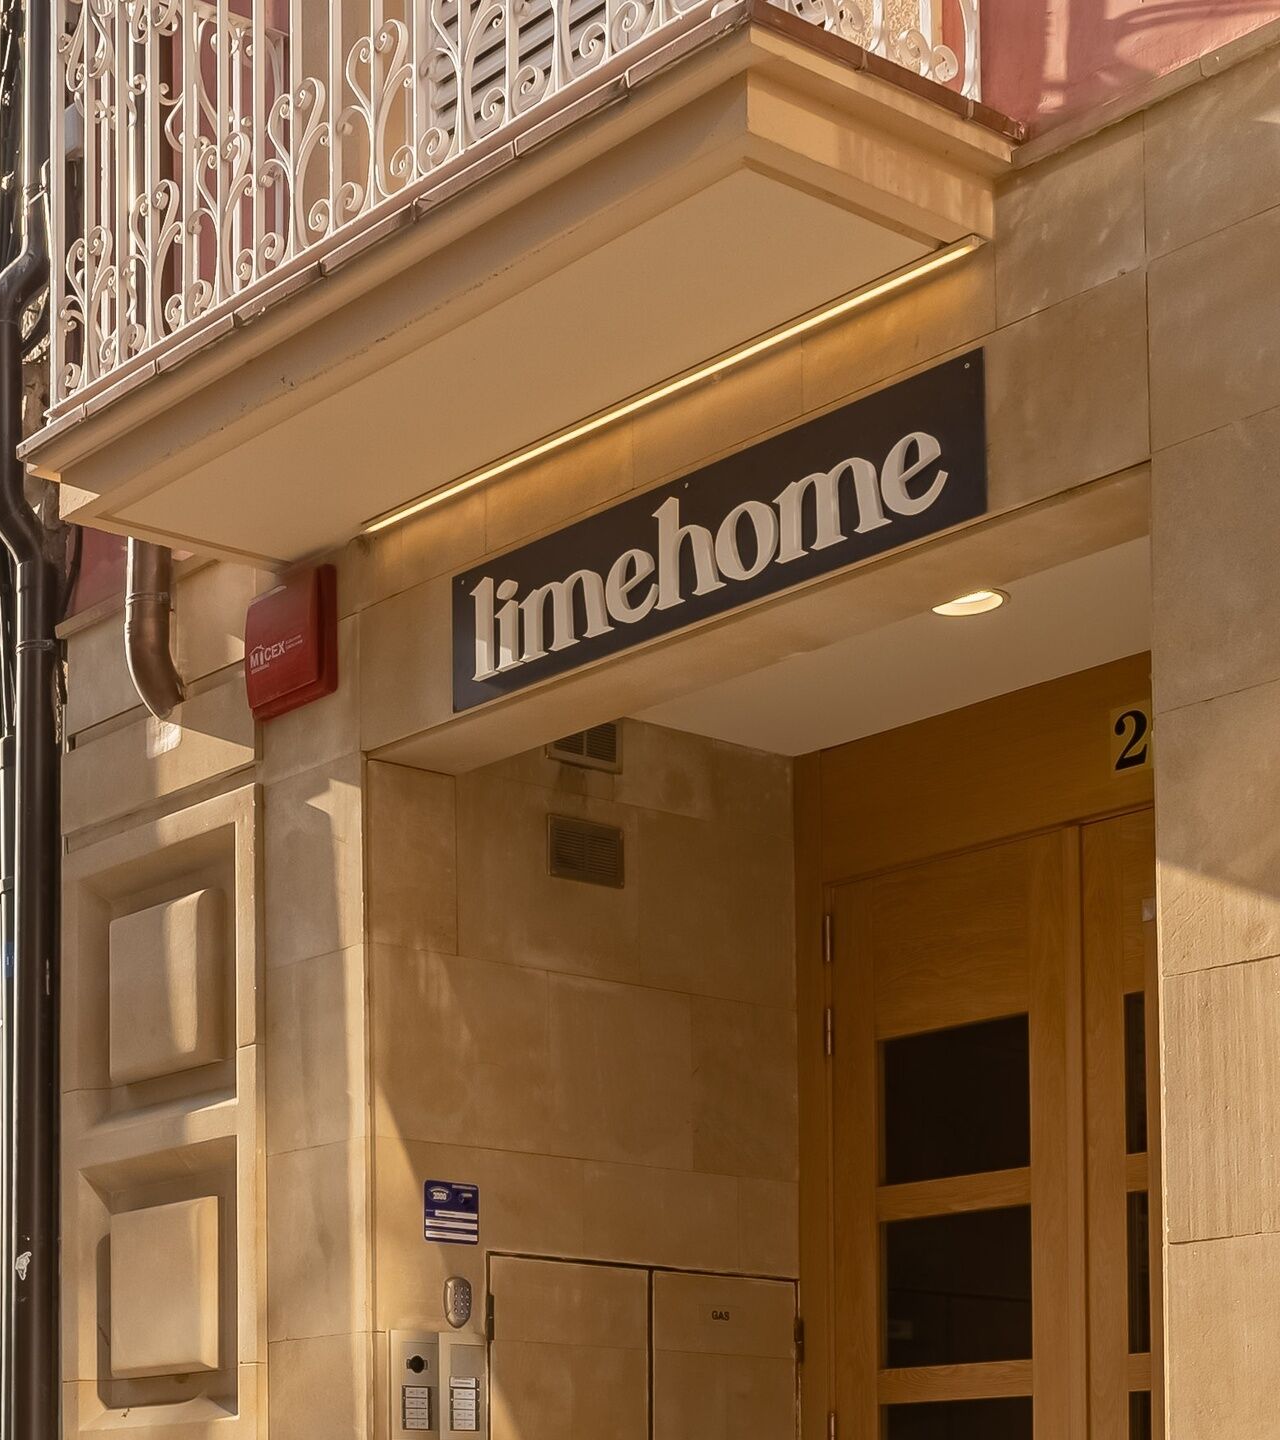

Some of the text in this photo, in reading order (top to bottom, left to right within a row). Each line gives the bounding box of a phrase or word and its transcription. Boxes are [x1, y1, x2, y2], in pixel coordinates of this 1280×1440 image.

[469, 430, 949, 683] limehome
[249, 641, 286, 669] MICEX
[1114, 709, 1148, 771] 2
[711, 1310, 730, 1321] GAS
